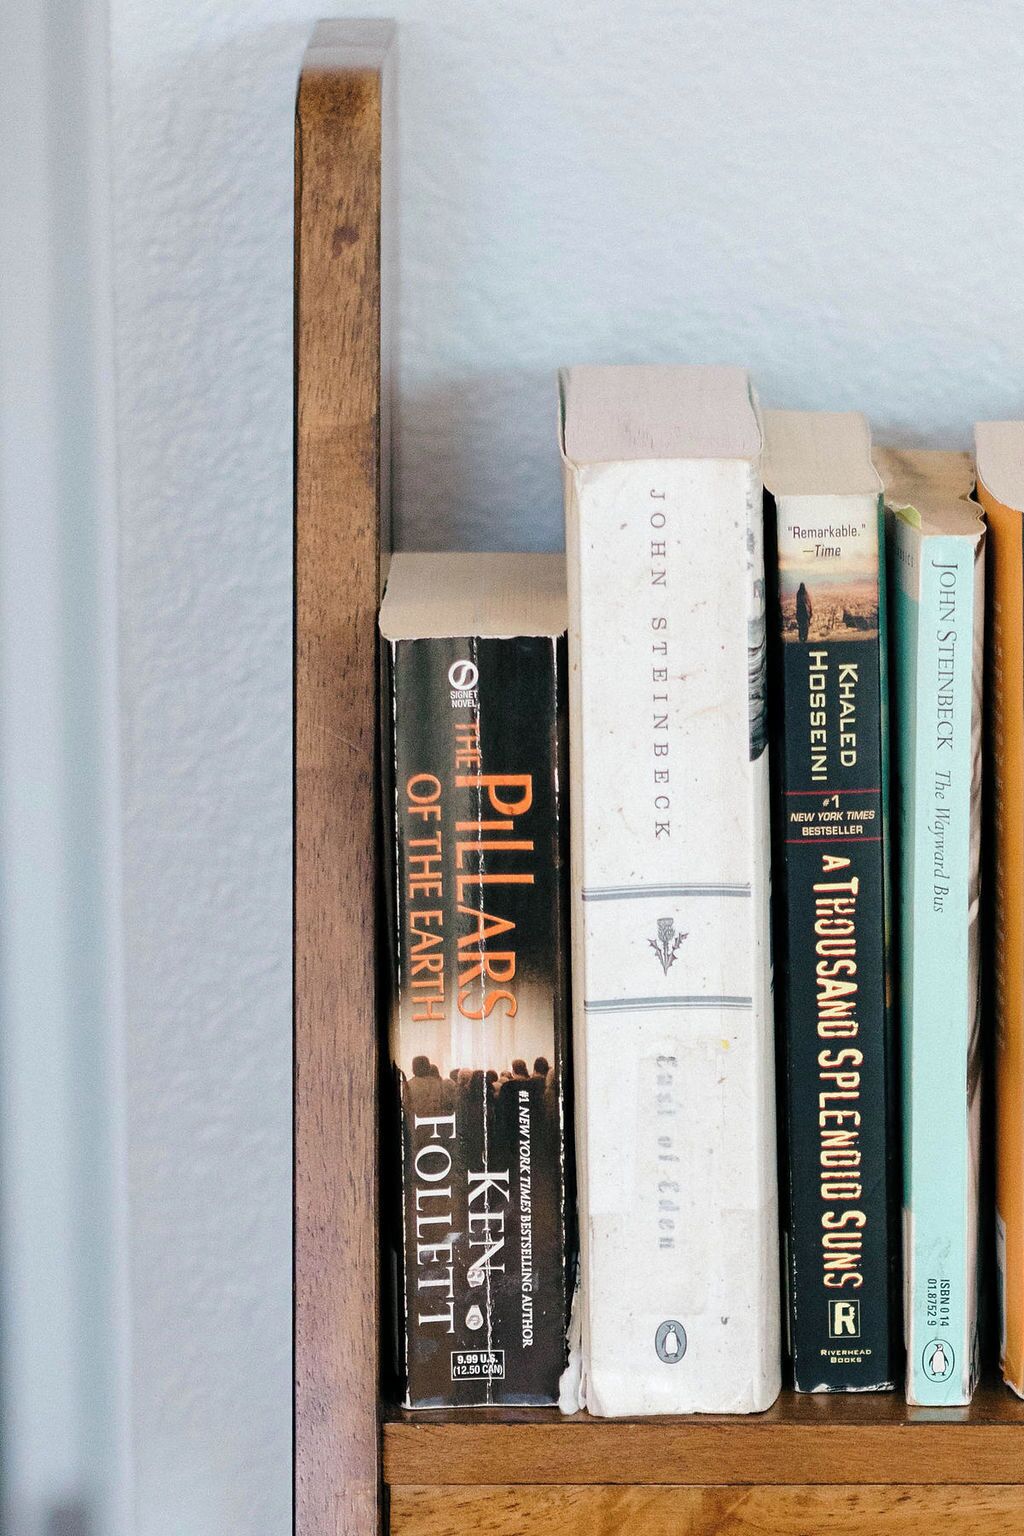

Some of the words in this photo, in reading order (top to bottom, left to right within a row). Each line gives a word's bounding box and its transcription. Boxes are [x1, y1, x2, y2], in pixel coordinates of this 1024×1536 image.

[649, 489, 666, 587] JOHN
[932, 560, 959, 622] JOHN
[450, 691, 478, 699] SIGNET
[452, 699, 477, 708] NOVEL
[936, 630, 957, 751] STEINBECK
[651, 616, 671, 839] STEINBECK
[808, 651, 829, 781] HOSSEINI
[838, 663, 859, 767] KHALED
[454, 723, 482, 768] THE
[406, 773, 442, 821] OF
[822, 795, 840, 809] #1
[934, 770, 952, 800] The
[790, 812, 815, 822] NEW
[817, 811, 843, 822] YORK
[846, 810, 875, 821] TIMES
[802, 825, 863, 836] BESTSELLER
[408, 831, 443, 899] THE
[822, 854, 851, 872] A
[927, 807, 951, 880] Wayward
[455, 773, 535, 1020] PILLARS
[933, 885, 950, 913] Bus
[409, 909, 446, 1022] EARTH
[813, 876, 860, 1039] THOUSAND
[518, 1090, 530, 1103] #1
[518, 1106, 531, 1138] NEW
[817, 1048, 864, 1201] SPLENDID
[519, 1139, 532, 1174] YORK
[520, 1175, 532, 1214] TIMES
[413, 1112, 457, 1334] FOLLETT
[467, 1169, 510, 1274] KEN
[520, 1214, 533, 1292] BESTSELLING
[820, 1210, 867, 1289] SUNS
[940, 1279, 950, 1305] ISBN
[521, 1294, 534, 1348] AUTHOR
[940, 1316, 950, 1327] 14
[453, 1365, 480, 1377] (12.50
[482, 1364, 503, 1376] CAN)
[457, 1354, 479, 1365] 9.99
[480, 1353, 498, 1364] U.S.
